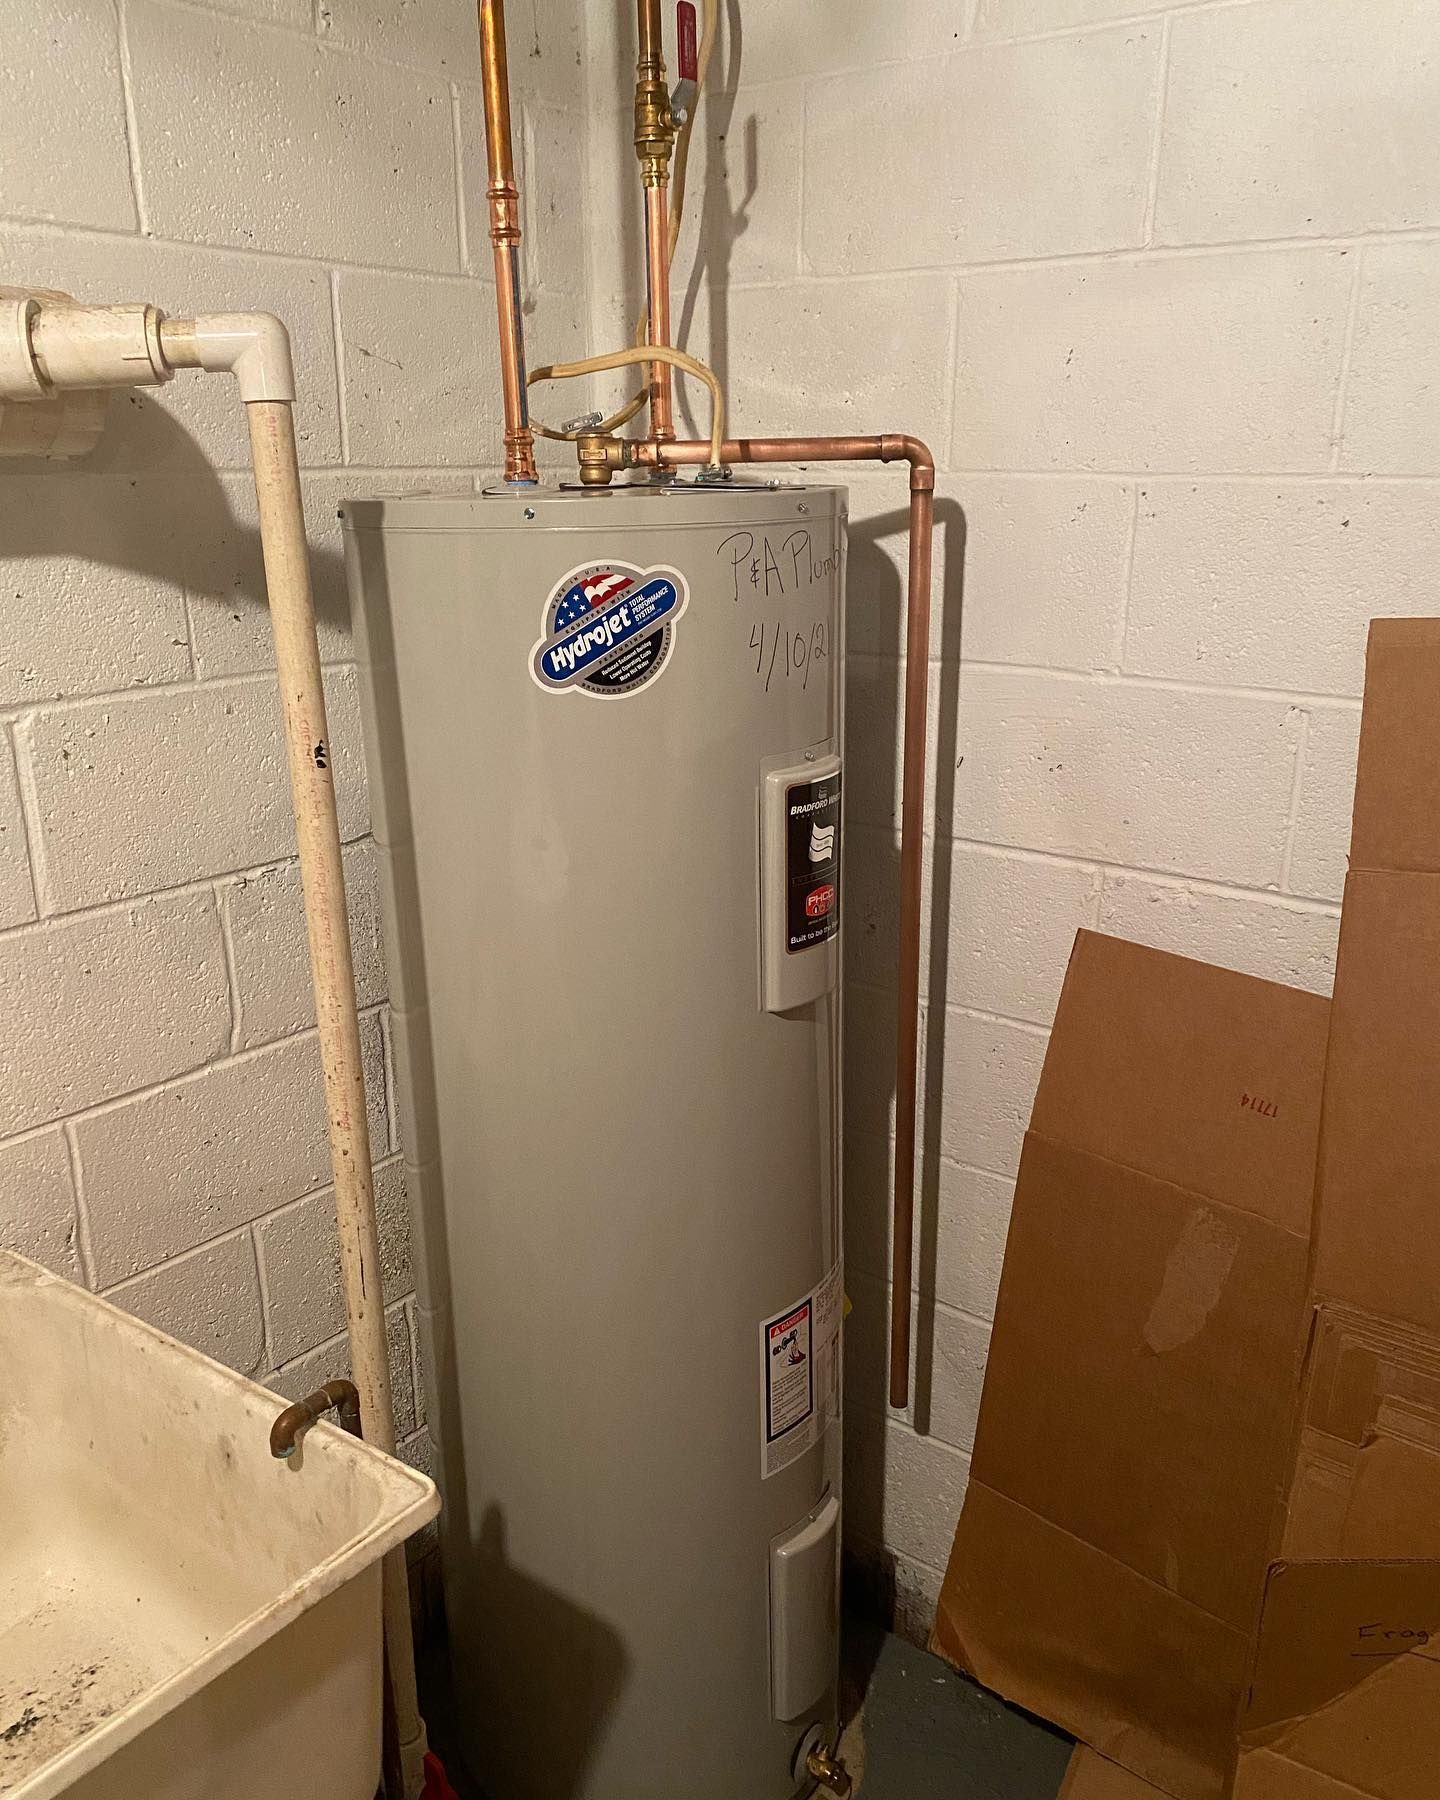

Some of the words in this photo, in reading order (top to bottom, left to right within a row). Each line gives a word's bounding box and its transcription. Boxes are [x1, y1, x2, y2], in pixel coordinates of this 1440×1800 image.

[565, 606, 606, 634] EQUIPPED
[611, 590, 631, 604] WITH
[628, 593, 645, 607] TOTAL
[632, 585, 669, 614] PERFORMANCE
[634, 603, 656, 622] SYSTEM
[550, 605, 631, 672] Hydrojet
[598, 633, 644, 664] FEATURING
[790, 798, 828, 816] BRADFORD
[1240, 1093, 1279, 1118] 17114
[1358, 1622, 1433, 1646] Frag
